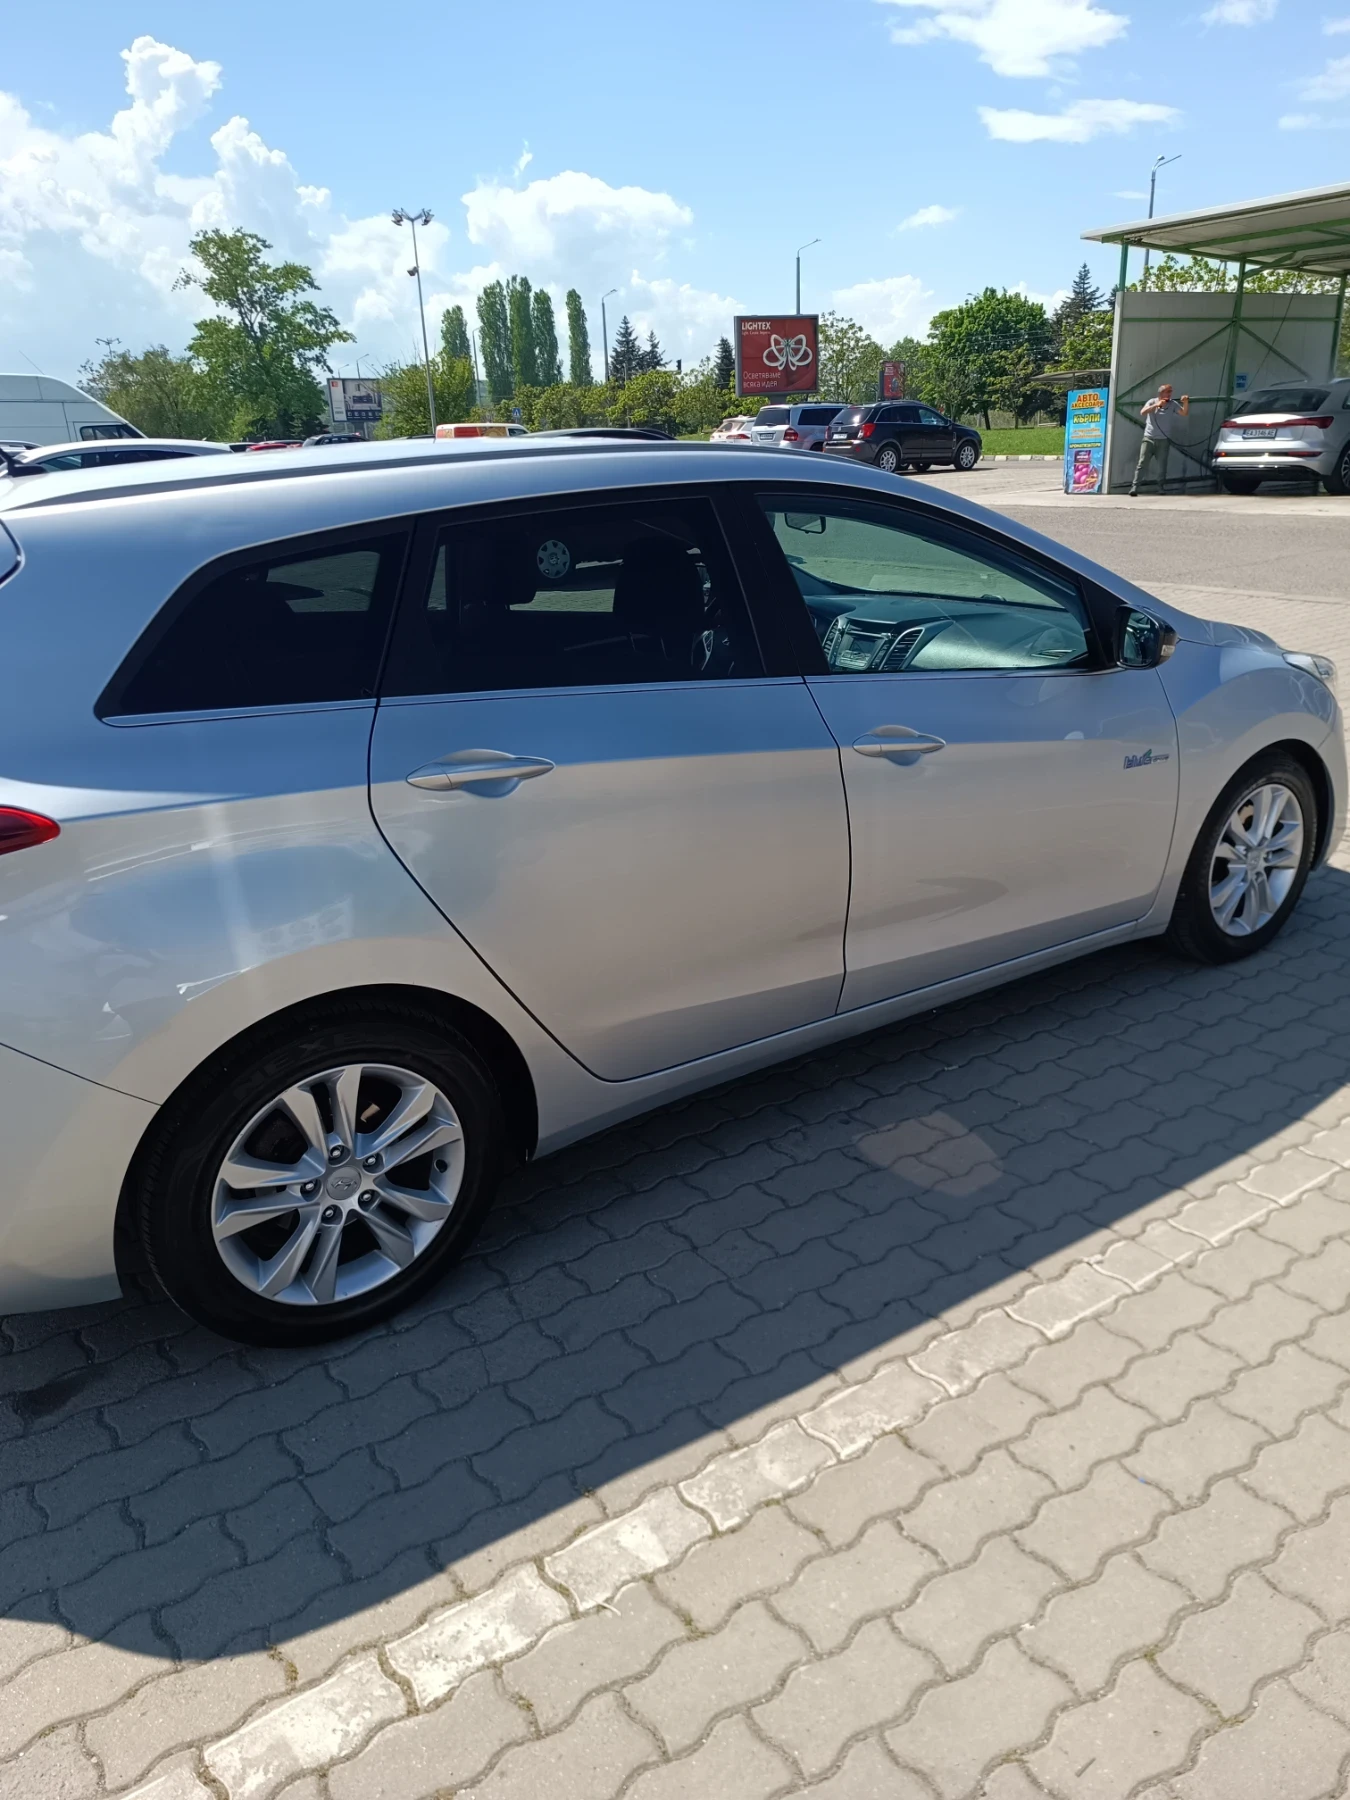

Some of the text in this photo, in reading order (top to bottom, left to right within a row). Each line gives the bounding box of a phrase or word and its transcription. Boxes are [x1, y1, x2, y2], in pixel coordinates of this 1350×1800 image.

[742, 322, 771, 331] LIGHTEX
[743, 371, 781, 380] Осветяваме
[762, 381, 778, 389] идея
[1077, 393, 1099, 402] АВТО
[1073, 413, 1100, 424] КЪРПИ
